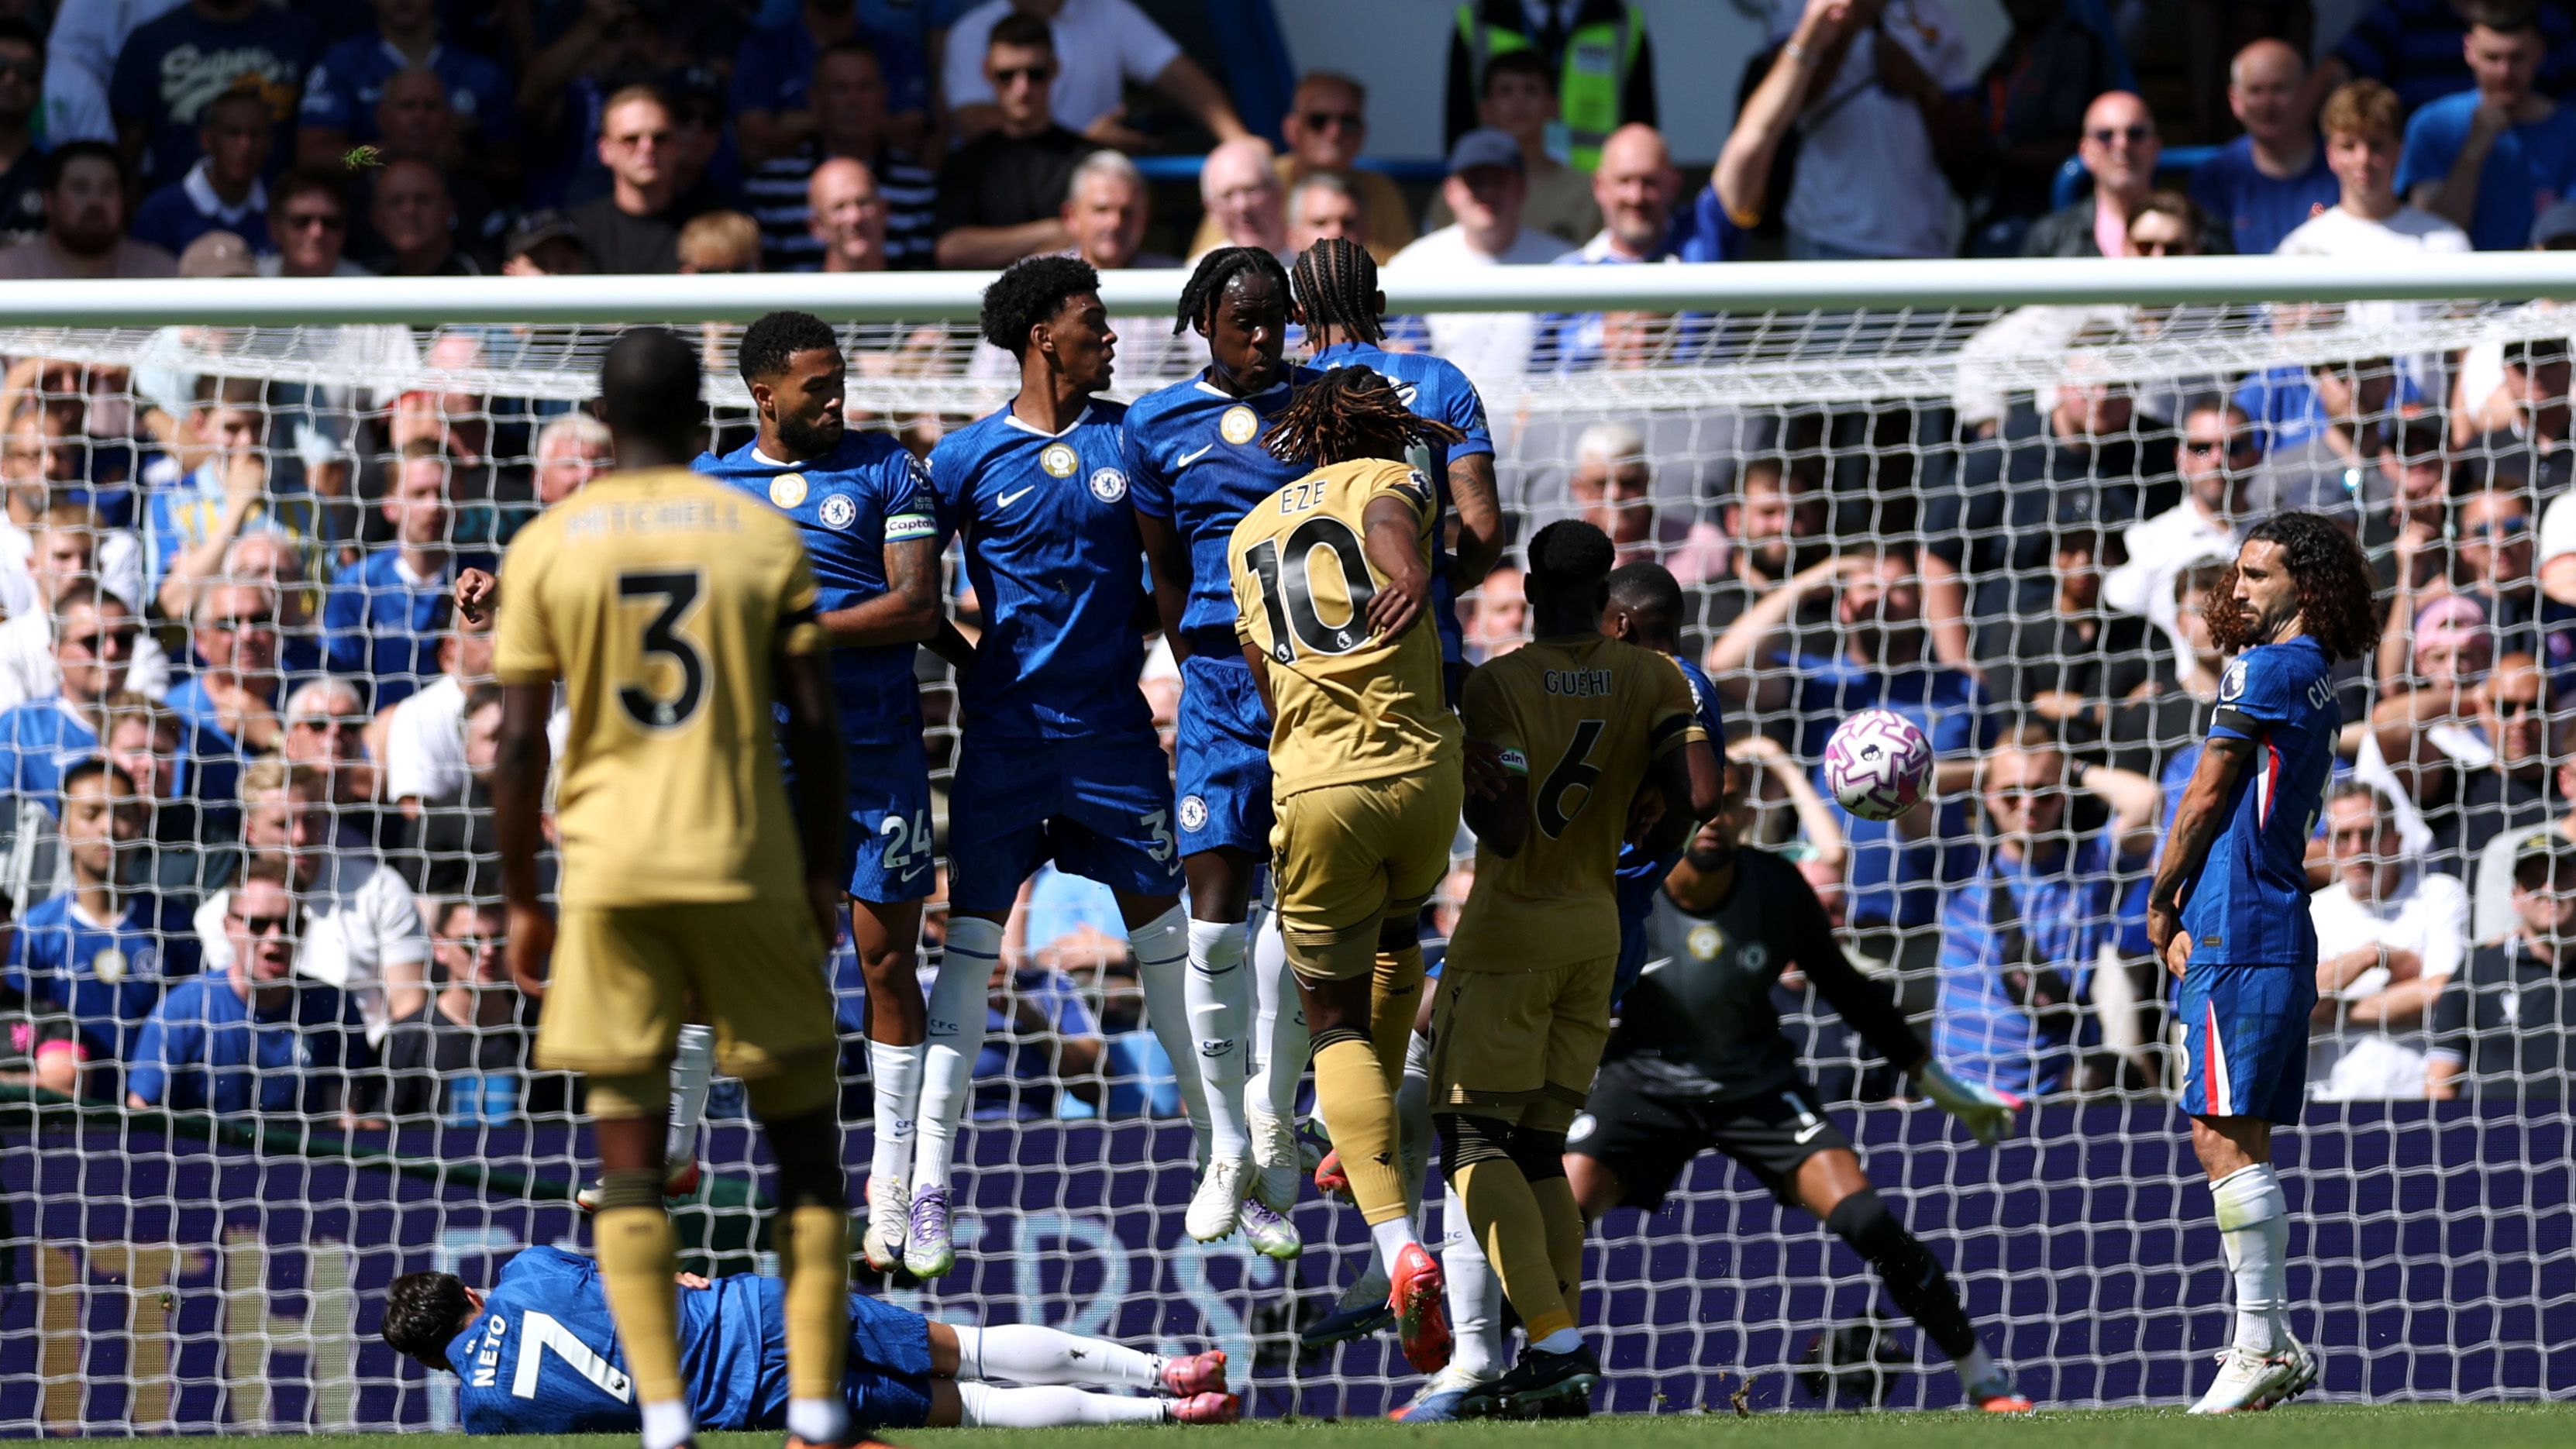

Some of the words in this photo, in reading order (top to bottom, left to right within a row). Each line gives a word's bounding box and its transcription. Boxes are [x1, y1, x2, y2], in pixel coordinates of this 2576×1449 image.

[567, 502, 742, 539] MITCHELL
[1280, 480, 1328, 515] EZE
[1245, 517, 1379, 664] 10
[618, 570, 708, 728] 3
[1544, 666, 1612, 697] GUÉHI
[1498, 752, 1524, 766] ain
[1535, 719, 1607, 841] 6
[880, 808, 932, 869] 24
[1140, 808, 1173, 862] 3
[1204, 1038, 1234, 1050] CFC
[471, 1314, 508, 1388] NETO
[511, 1309, 632, 1405] 7
